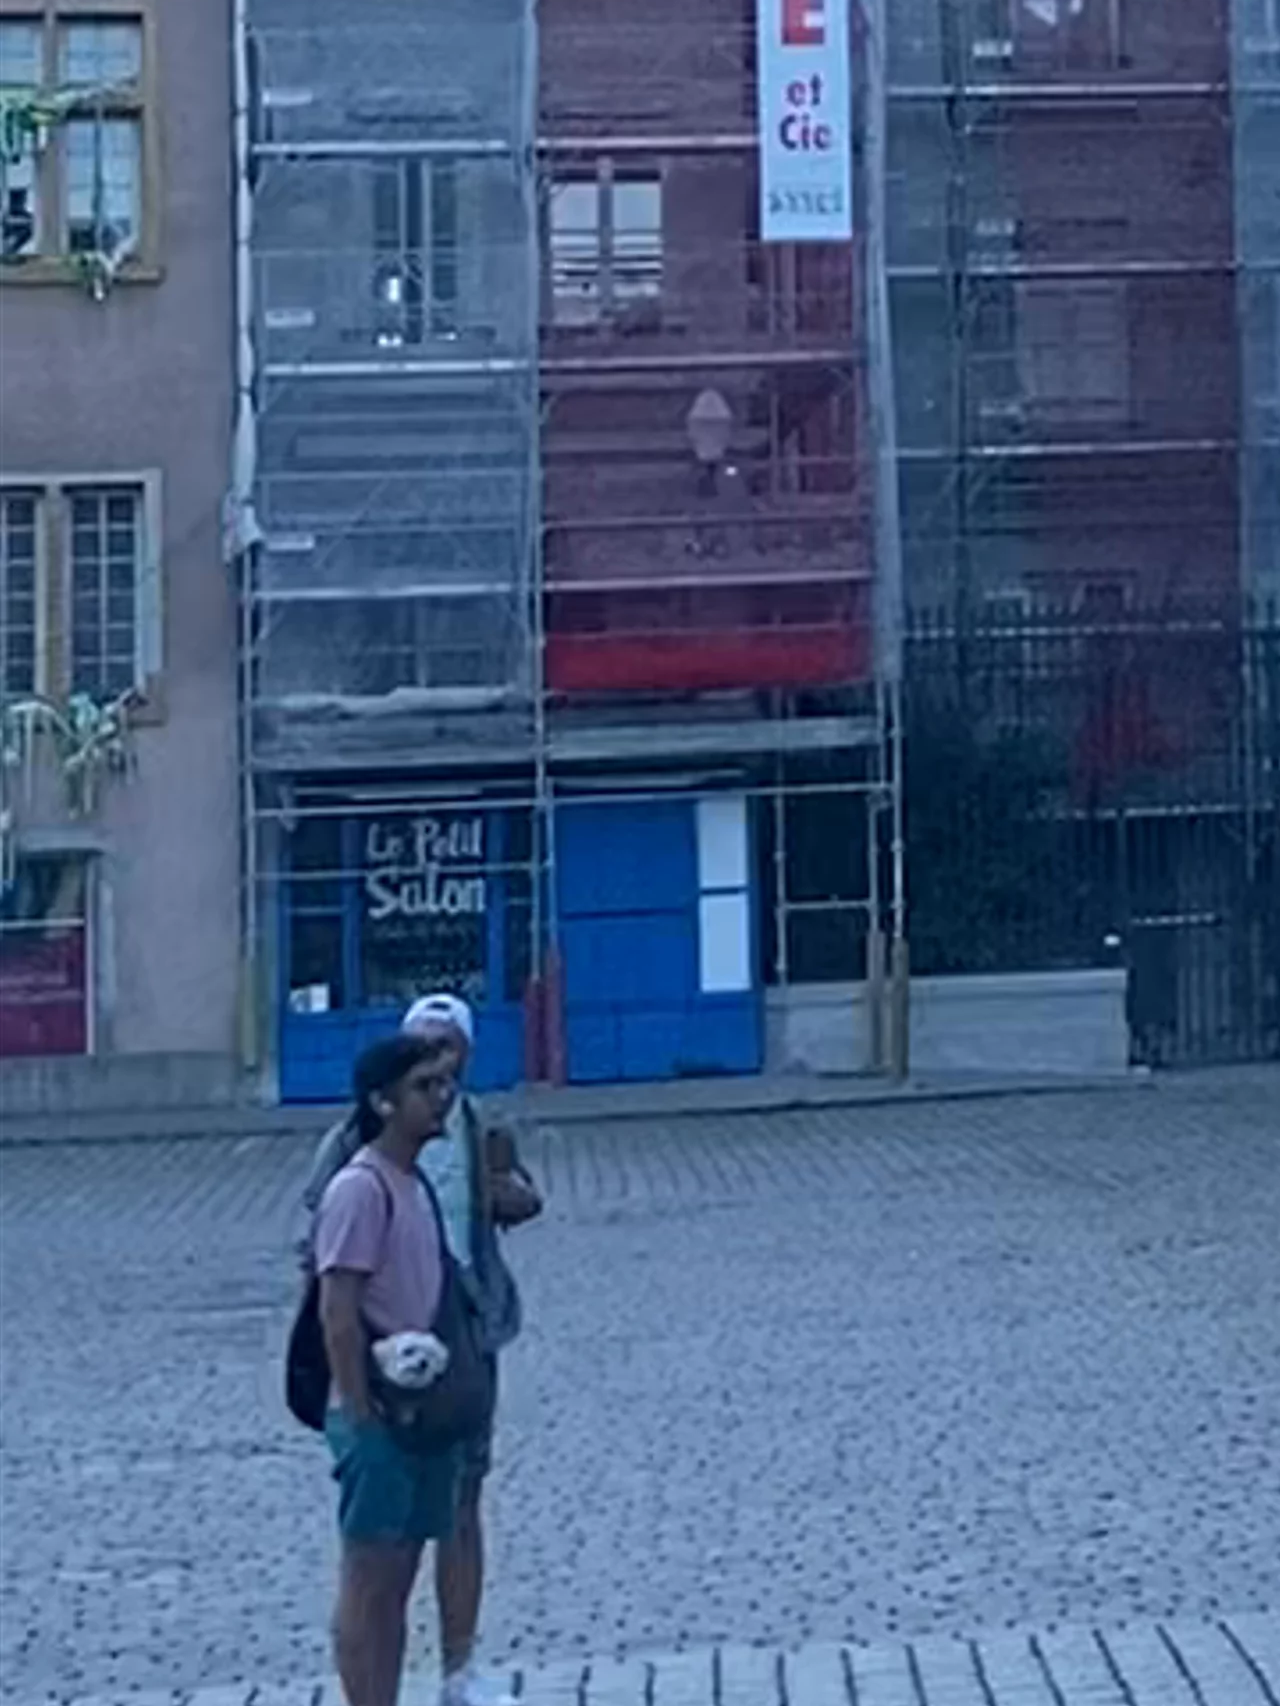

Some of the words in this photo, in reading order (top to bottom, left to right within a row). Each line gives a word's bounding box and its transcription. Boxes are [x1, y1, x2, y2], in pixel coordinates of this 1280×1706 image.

[785, 74, 822, 106] et
[778, 114, 832, 151] Cie
[367, 821, 404, 861] Le
[410, 817, 484, 867] Petit
[365, 861, 487, 920] Salon
